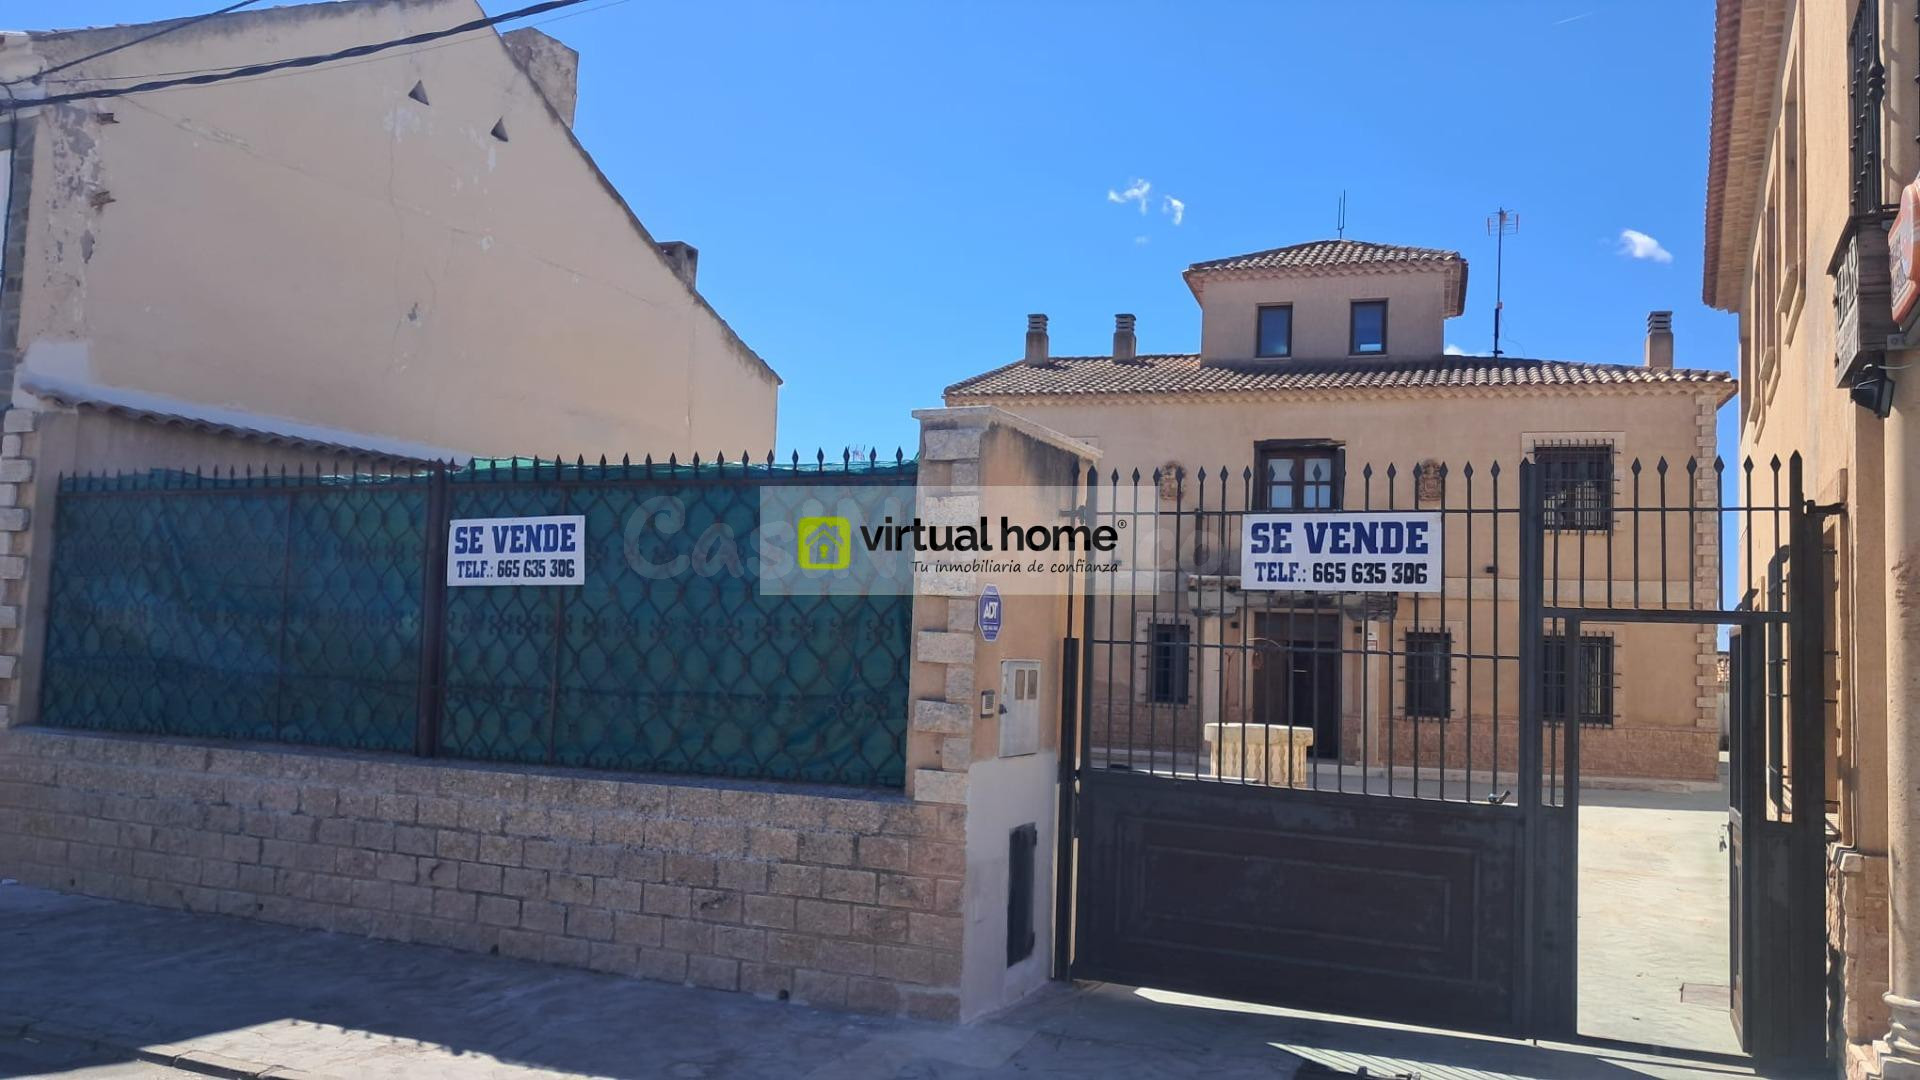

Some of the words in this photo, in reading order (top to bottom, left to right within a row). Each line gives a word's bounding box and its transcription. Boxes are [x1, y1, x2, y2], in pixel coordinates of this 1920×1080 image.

[455, 526, 483, 555] SE
[492, 523, 576, 554] VENDE
[1251, 522, 1292, 554] SE
[1304, 521, 1428, 554] VENDE
[457, 560, 494, 578] TELF.:
[497, 559, 520, 578] 665
[523, 559, 546, 578] 635
[549, 558, 575, 578] 306
[1255, 562, 1307, 582] TELF.:
[1312, 562, 1346, 583] 665
[1351, 562, 1387, 583] 635
[1391, 562, 1428, 584] 306
[983, 601, 999, 619] ADT
